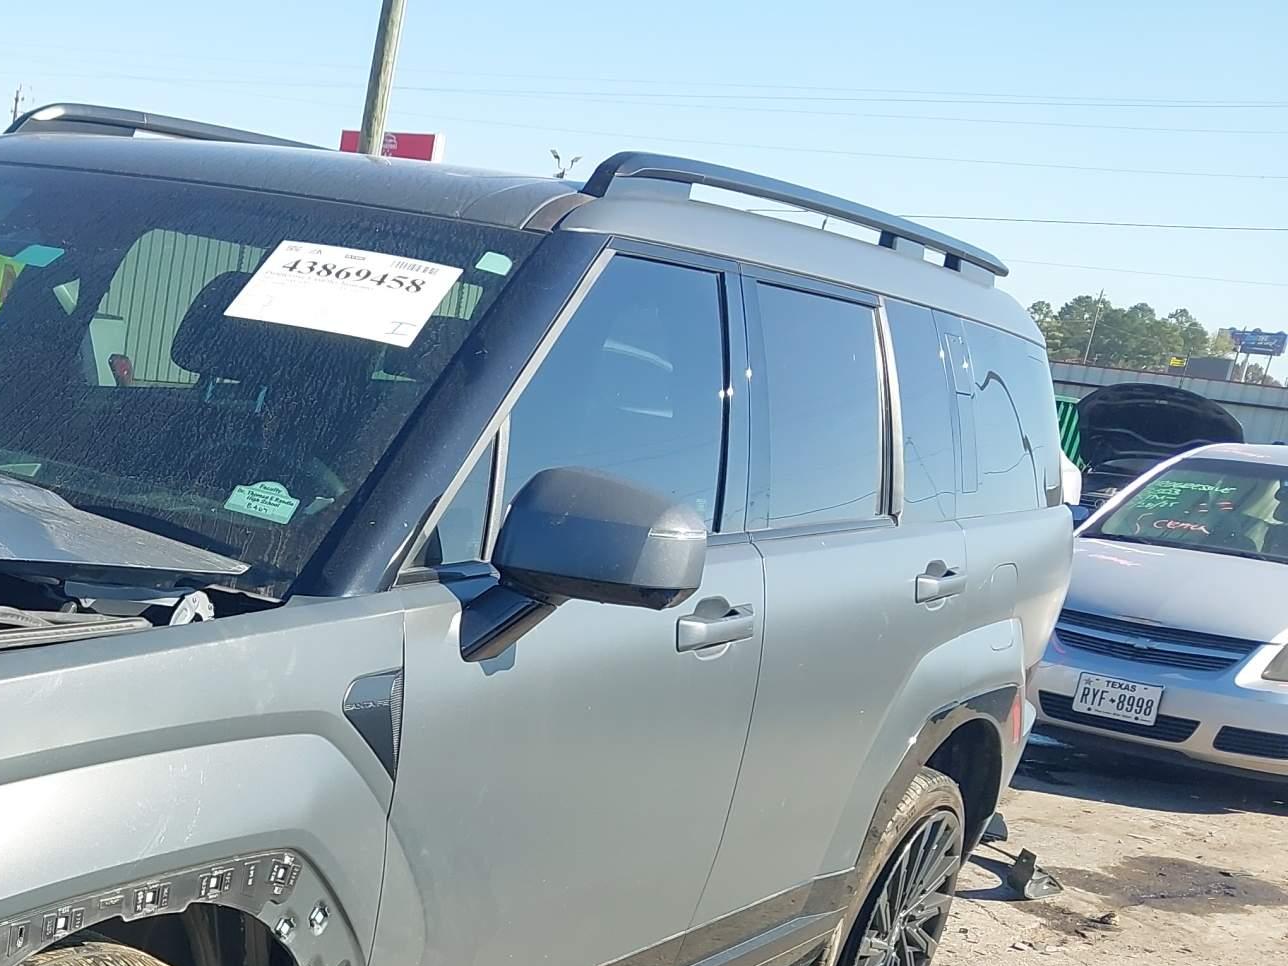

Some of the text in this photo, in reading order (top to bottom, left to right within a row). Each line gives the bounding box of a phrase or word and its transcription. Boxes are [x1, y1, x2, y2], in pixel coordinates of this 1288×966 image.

[281, 258, 427, 294] 43869458
[260, 484, 282, 493] Faculty
[248, 490, 269, 499] Thomas
[260, 499, 281, 507] School
[1105, 680, 1137, 693] TEXAS
[1116, 693, 1154, 717] 8998
